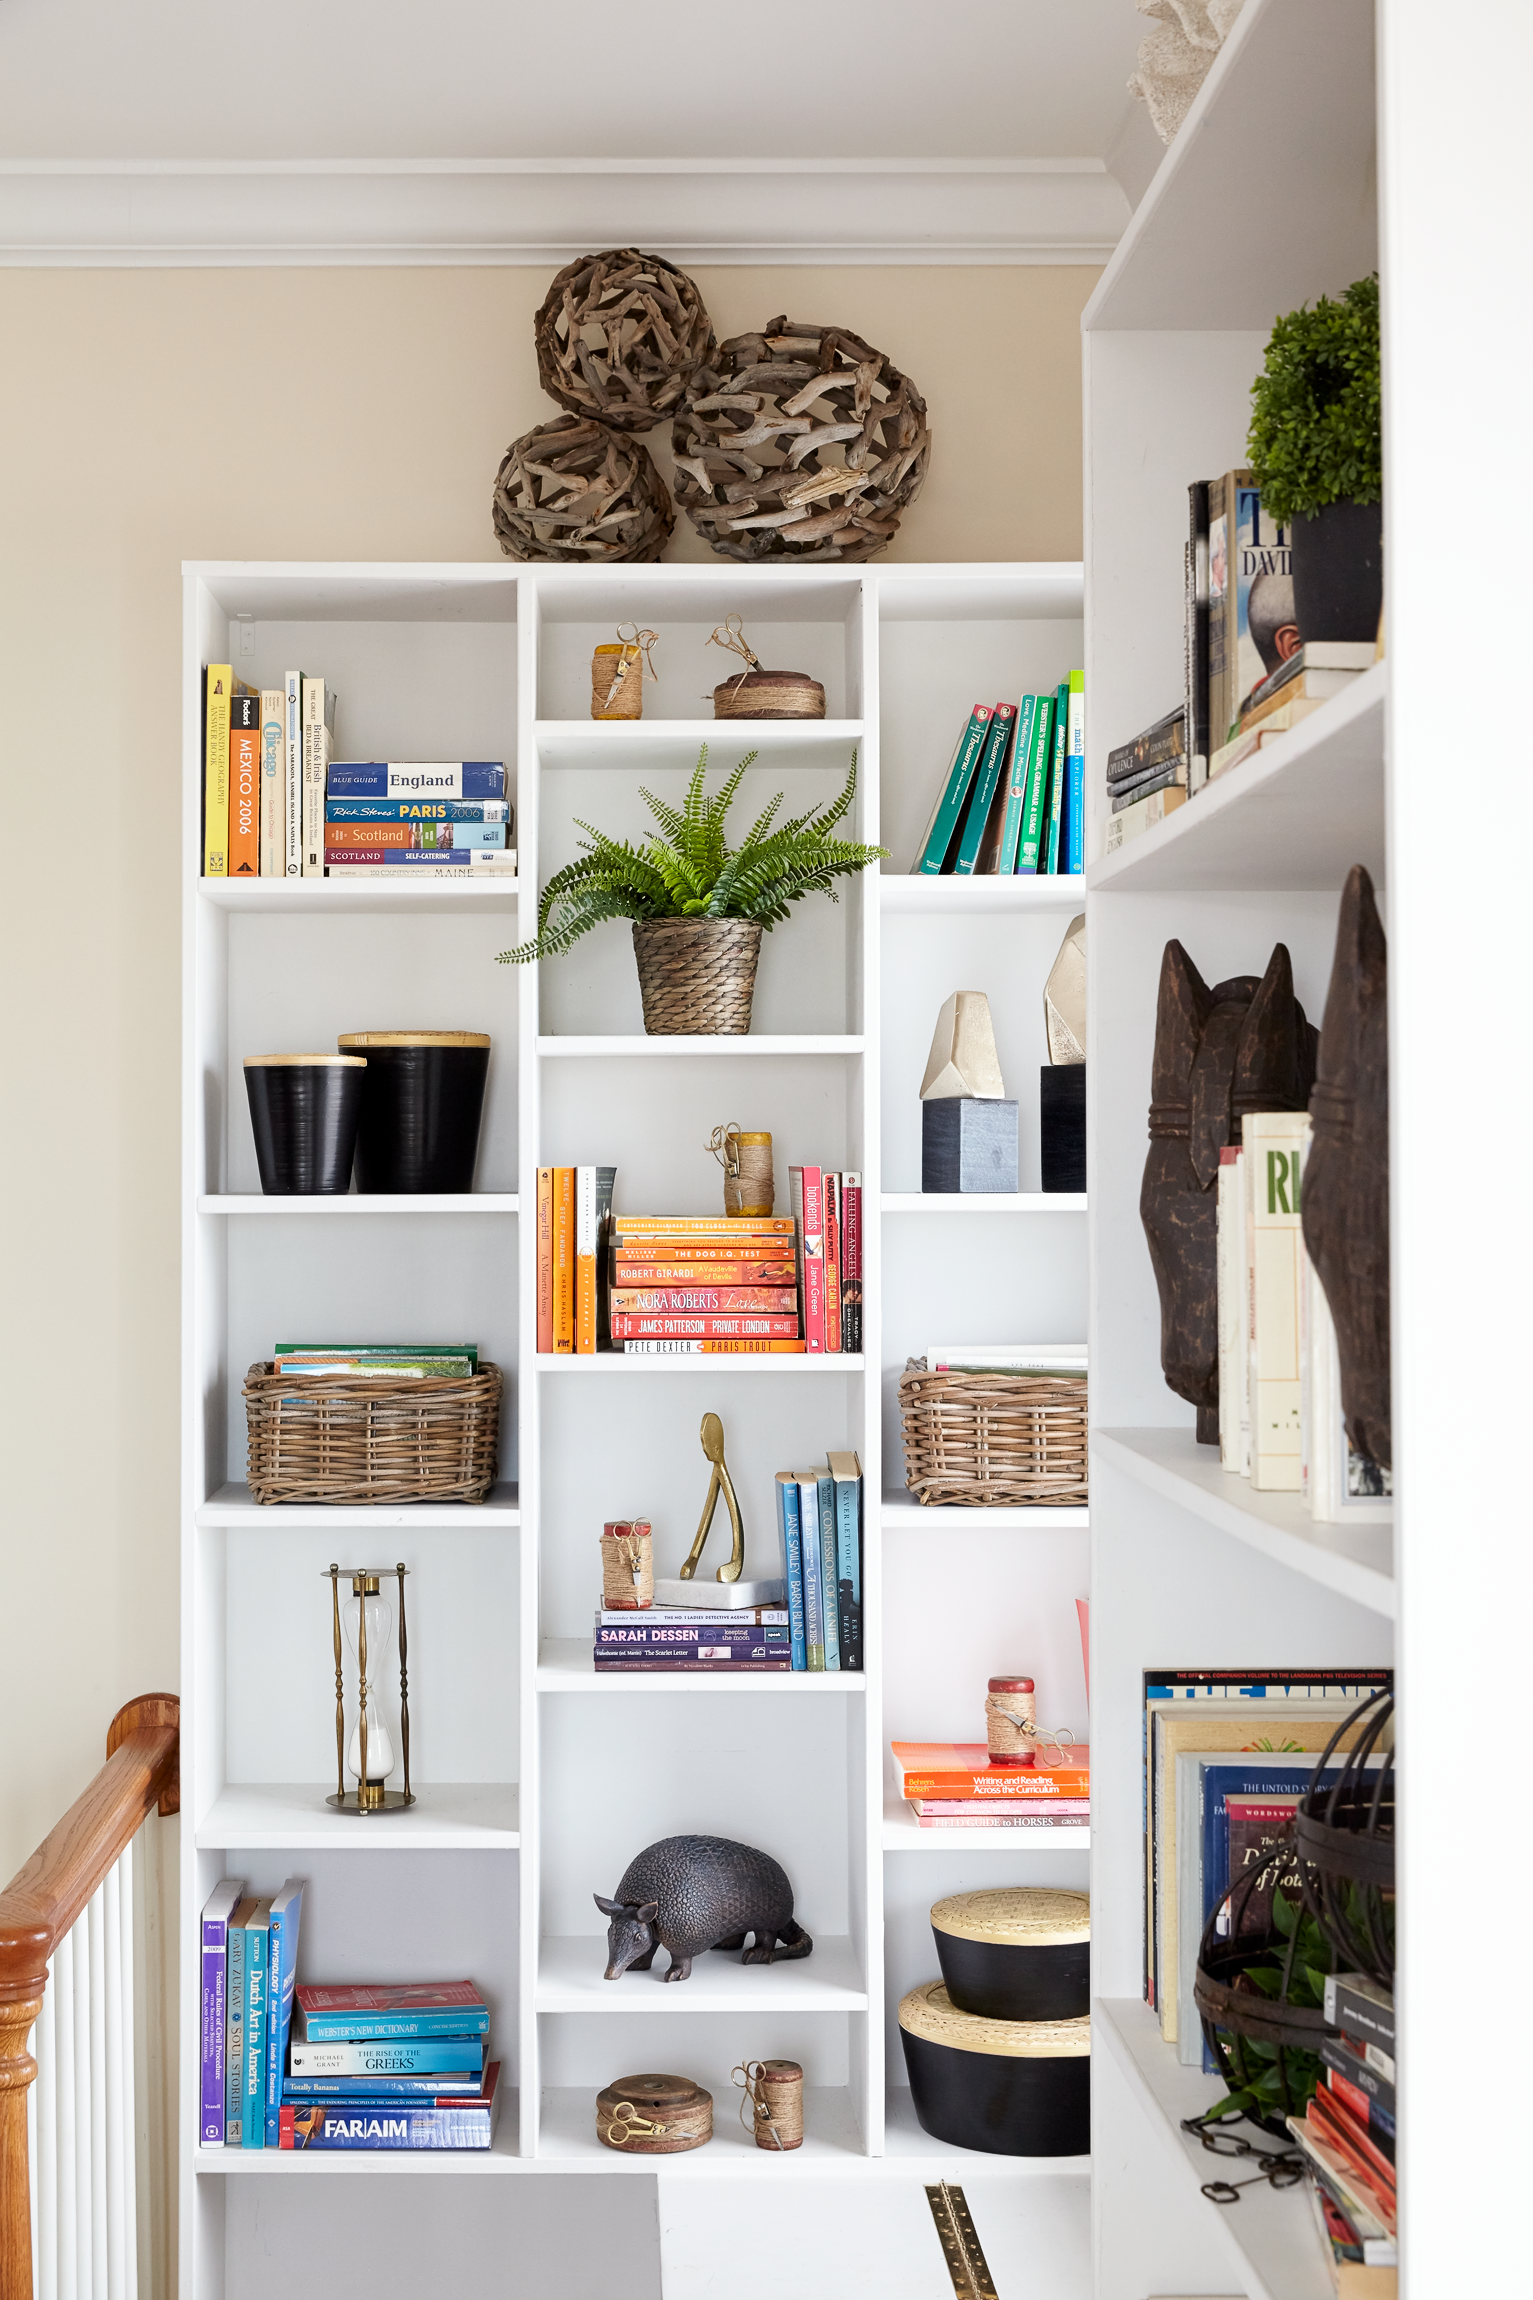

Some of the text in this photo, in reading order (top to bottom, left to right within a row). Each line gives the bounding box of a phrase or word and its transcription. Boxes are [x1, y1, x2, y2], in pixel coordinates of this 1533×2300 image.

[242, 699, 251, 726] Fodor's
[1024, 699, 1033, 718] Love,
[1019, 718, 1029, 748] Medicine
[1038, 702, 1049, 740] WEBSTER'S
[210, 705, 218, 765] ANSWER BOOK
[313, 724, 321, 753] British
[1074, 729, 1083, 754] math
[217, 705, 226, 805] THE HANDY GEOGRAPHY
[263, 721, 283, 777] Chicago
[961, 733, 981, 771] Thesaurus
[987, 730, 1005, 770] Thesaurus
[1034, 740, 1045, 771] SPELLING,
[313, 763, 321, 783] Irish
[390, 774, 454, 789] England
[1014, 756, 1024, 784] Miracles
[239, 738, 252, 835] MEXICO 2006
[1031, 771, 1042, 808] GRAMMAR
[333, 808, 358, 816] Rick
[399, 805, 446, 818] PARIS
[450, 807, 481, 818] 2006
[352, 829, 403, 841] Scotland
[1028, 813, 1037, 835] USAGE
[405, 852, 450, 860] SELF-CATERING
[539, 1196, 549, 1240] Vinegar Hill
[807, 1186, 820, 1230] bookends
[848, 1191, 857, 1277] FALLING ANGELS
[720, 1251, 736, 1259] I.Q.
[620, 1268, 694, 1279] ROBERT GIRARDI
[810, 1264, 819, 1316] Jane Green
[828, 1264, 837, 1309] GEORGE CARLIN
[636, 1293, 719, 1309] NORA ROBERTS
[637, 1319, 705, 1333] JAMES PATTERSON
[712, 1320, 770, 1334] PRIVATE LONDON
[629, 1341, 691, 1352] PETE DEXTER
[711, 1340, 772, 1352] PARIS TROUT
[787, 1513, 800, 1575] JANE SMILEY
[822, 1510, 837, 1644] CONFESSIONS OF A KNIFE
[845, 1565, 852, 1577] GO
[791, 1580, 803, 1640] BARN BLIND
[807, 1583, 816, 1621] THOUSAND
[600, 1630, 699, 1641] SARAH DESSEN
[809, 1621, 818, 1645] ACRES
[973, 1776, 1053, 1786] Writing and Reading
[973, 1785, 1060, 1794] Across the Curriculum
[1242, 1783, 1259, 1793] THE
[1262, 1784, 1299, 1794] UNTOLD
[935, 1817, 1054, 1827] FIELD GUIDE to HORSES
[232, 1933, 241, 2008] GARY ZUKAV
[271, 1939, 280, 1994] PHYSIOLOGY
[250, 1970, 264, 2005] Dutch
[215, 1996, 223, 2017] Rules
[250, 2008, 263, 2029] Art
[249, 2031, 261, 2043] in
[317, 2023, 419, 2037] WEBSTER'S NEW DICTIONARY
[231, 2027, 242, 2113] SOUL STORIES
[248, 2047, 262, 2096] America
[365, 2057, 415, 2070] GREEKS
[290, 2083, 340, 2092] Totally Bananas
